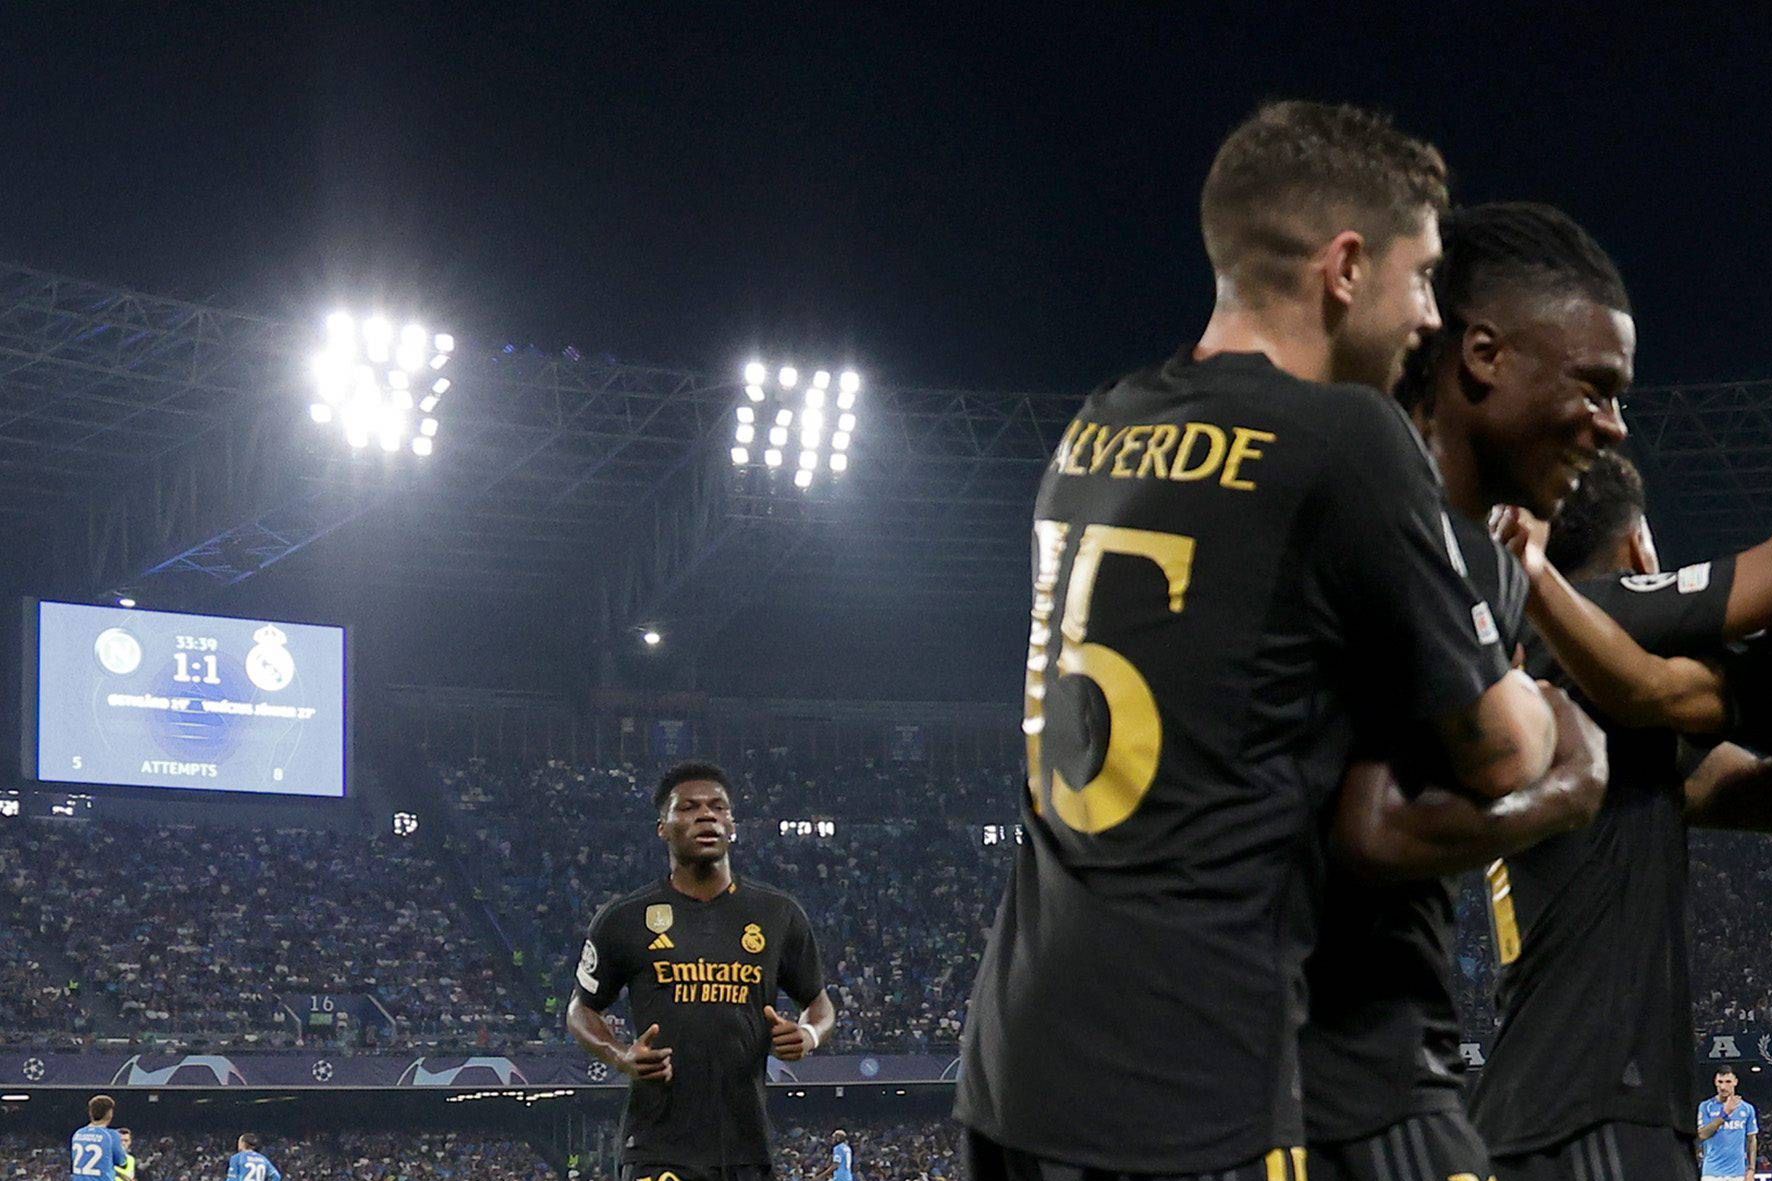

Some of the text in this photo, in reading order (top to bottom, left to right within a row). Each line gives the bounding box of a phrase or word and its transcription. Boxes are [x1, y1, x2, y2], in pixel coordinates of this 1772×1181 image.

[175, 635, 218, 651] 33:39
[173, 652, 221, 685] 1:1
[72, 756, 82, 770] 5
[141, 760, 218, 778] ATTEMPTS
[652, 957, 763, 984] Emirates
[310, 995, 334, 1012] 16
[674, 983, 750, 1004] FLY BETTER
[72, 1142, 103, 1176] 22
